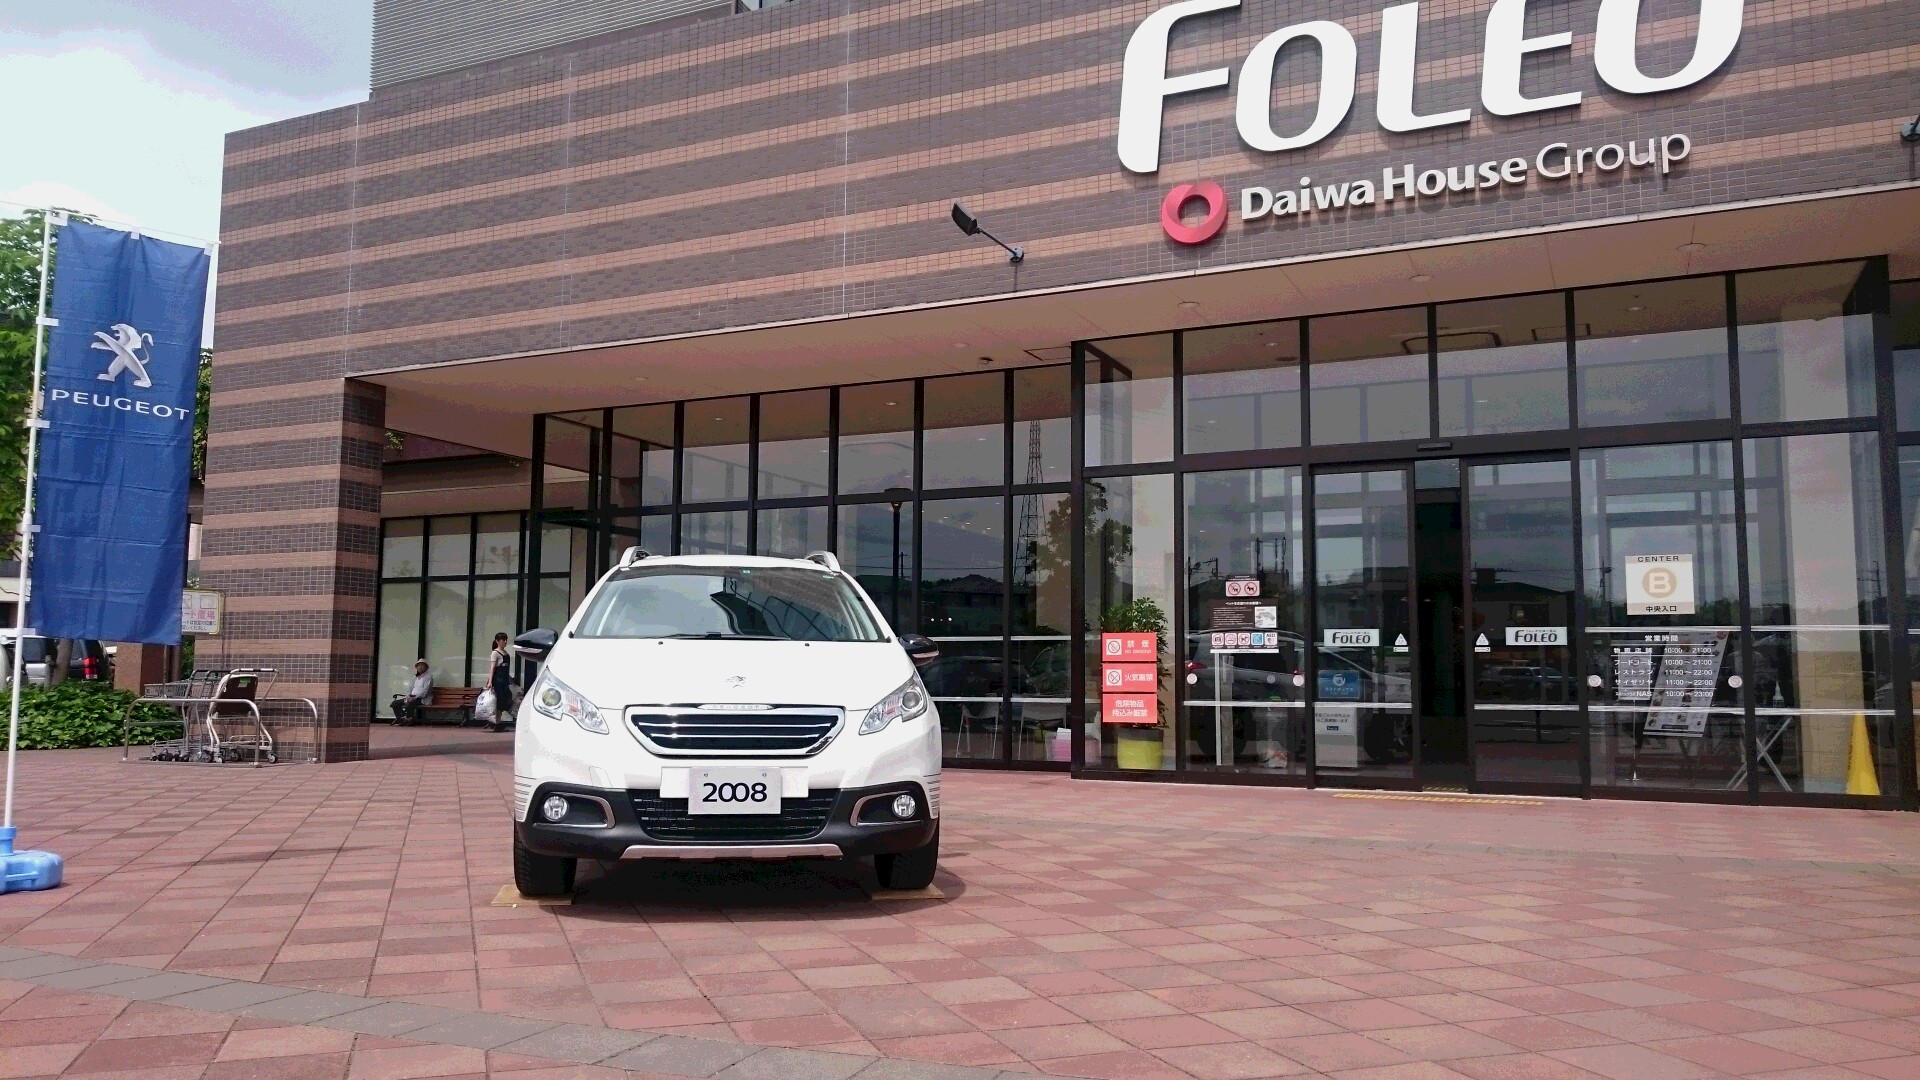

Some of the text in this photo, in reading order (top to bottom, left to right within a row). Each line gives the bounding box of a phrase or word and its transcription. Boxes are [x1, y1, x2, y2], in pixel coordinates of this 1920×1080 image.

[1117, 0, 1745, 173] FOLEO
[1241, 134, 1691, 219] Daiwa House Group
[51, 389, 190, 420] PEUGEOT
[1637, 555, 1679, 563] CENTER
[1649, 572, 1671, 593] B
[1645, 605, 1677, 613] 中央入口
[1332, 631, 1371, 644] FOLEO
[1515, 629, 1558, 643] FOLEO
[1644, 634, 1679, 642] 営業時間
[1115, 700, 1145, 708] 危険物品
[1112, 709, 1148, 717] 持込み厳禁
[702, 782, 768, 803] 2008
